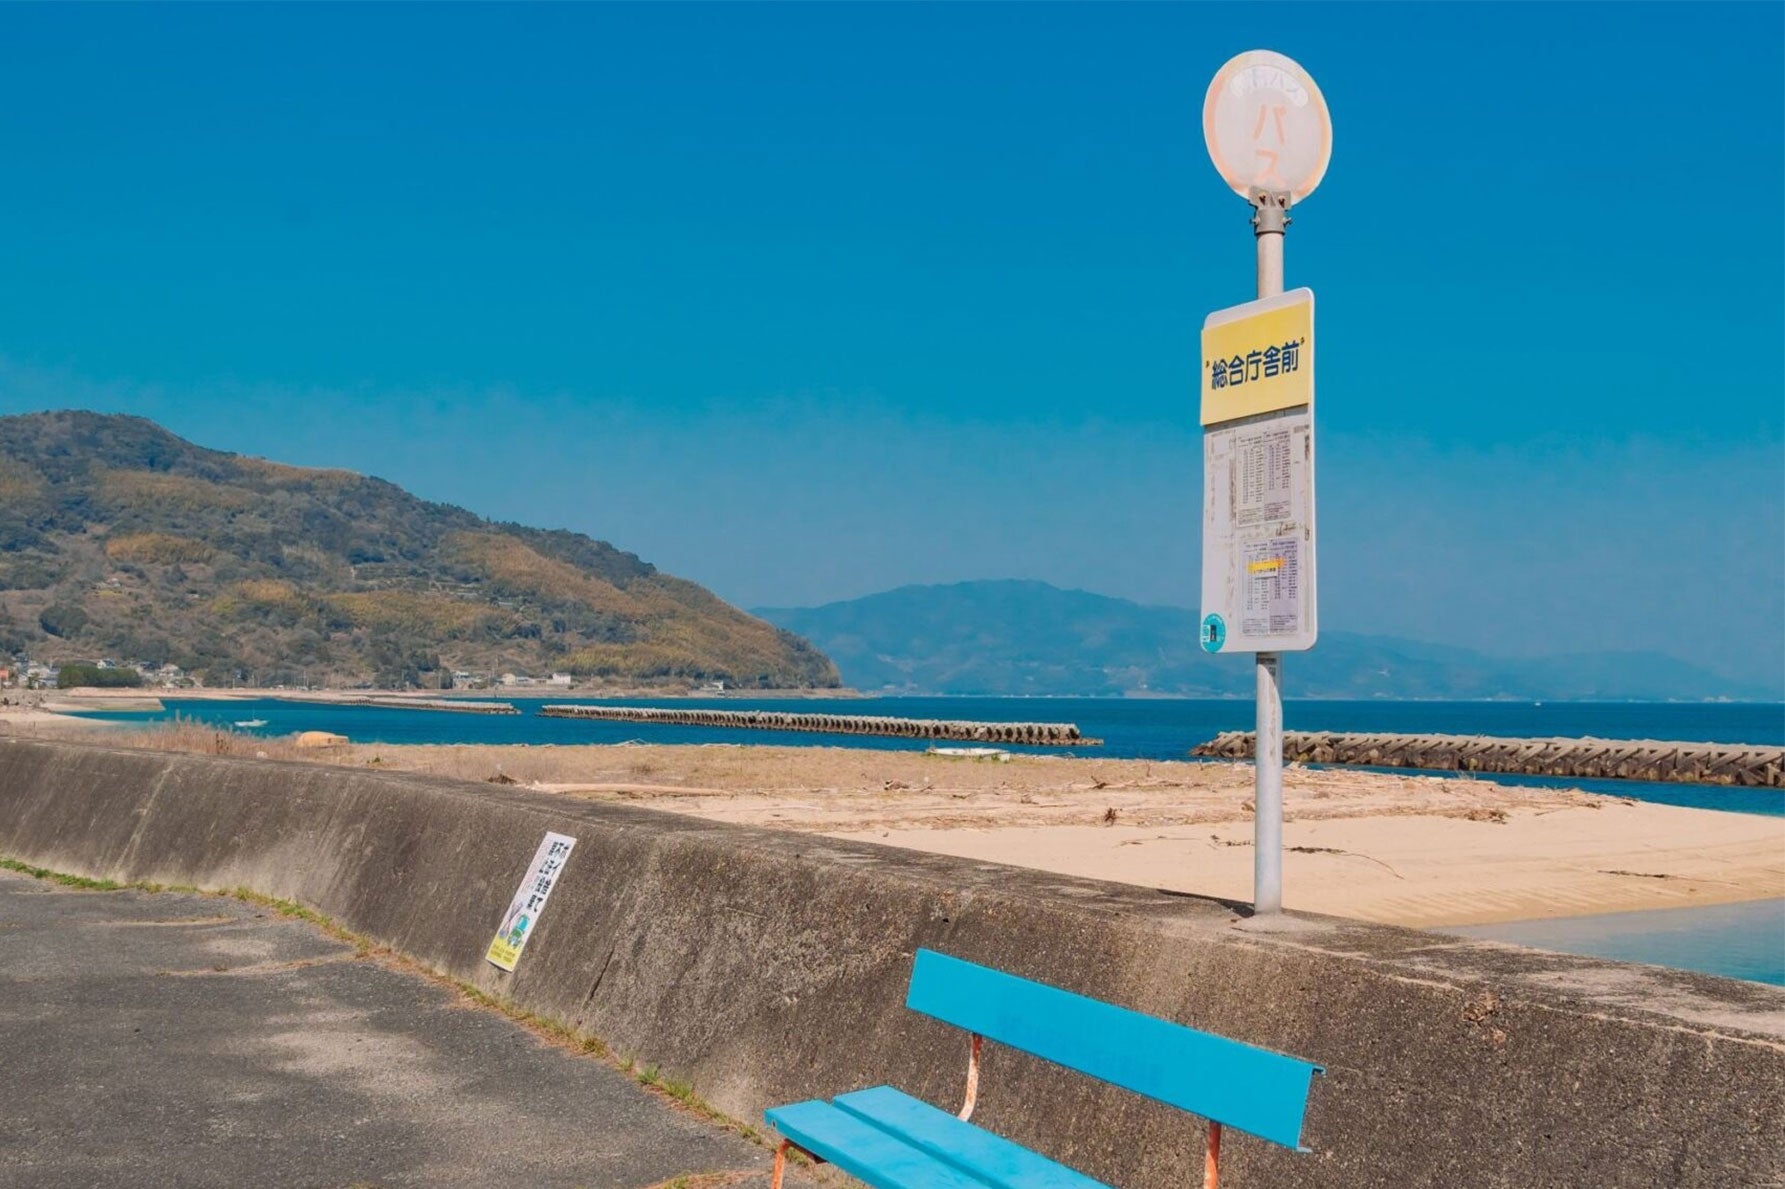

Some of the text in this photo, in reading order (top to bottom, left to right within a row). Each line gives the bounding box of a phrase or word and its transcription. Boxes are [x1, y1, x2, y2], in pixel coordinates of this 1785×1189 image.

[1252, 103, 1288, 187] バス
[1211, 340, 1300, 390] 総合庁舎前
